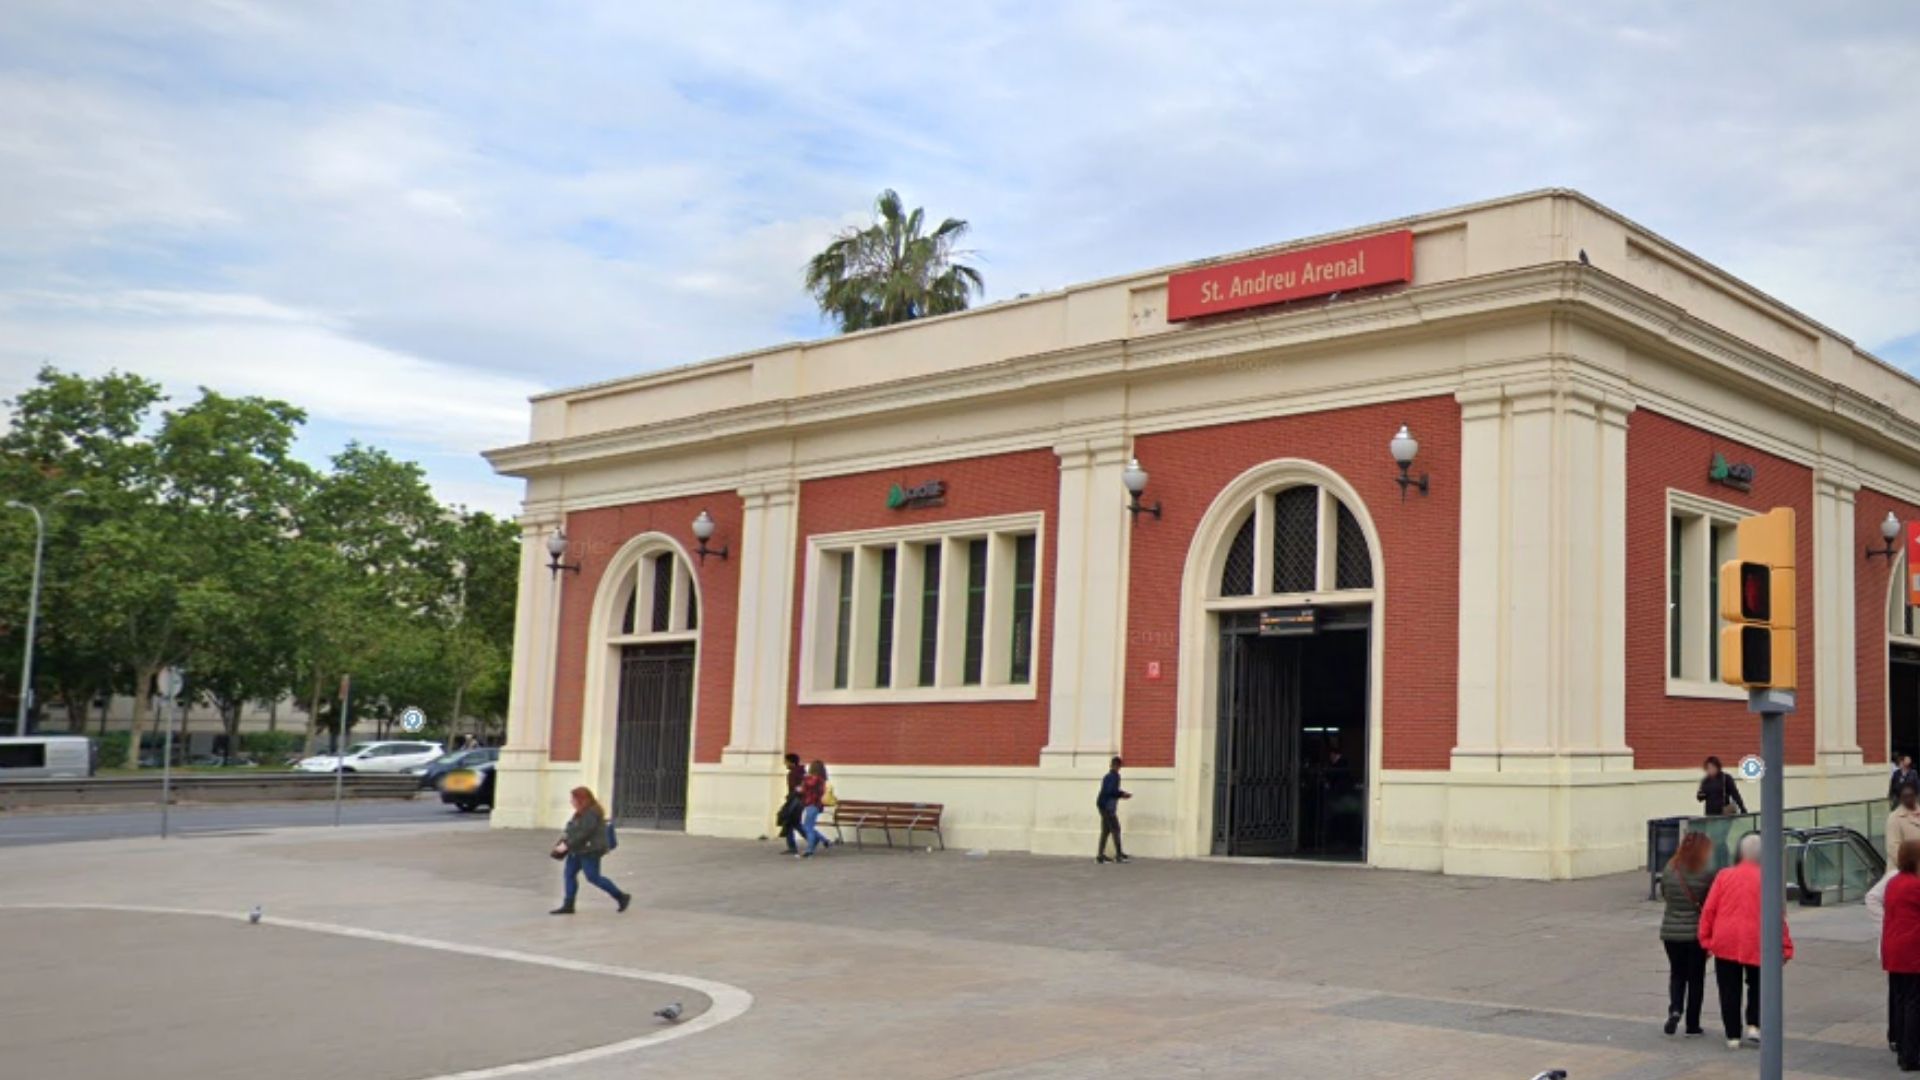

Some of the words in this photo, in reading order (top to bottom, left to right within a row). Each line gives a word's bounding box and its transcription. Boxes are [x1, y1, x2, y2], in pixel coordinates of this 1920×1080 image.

[1201, 280, 1224, 303] St.
[1230, 271, 1296, 298] Andreu
[1301, 250, 1365, 284] Arenal
